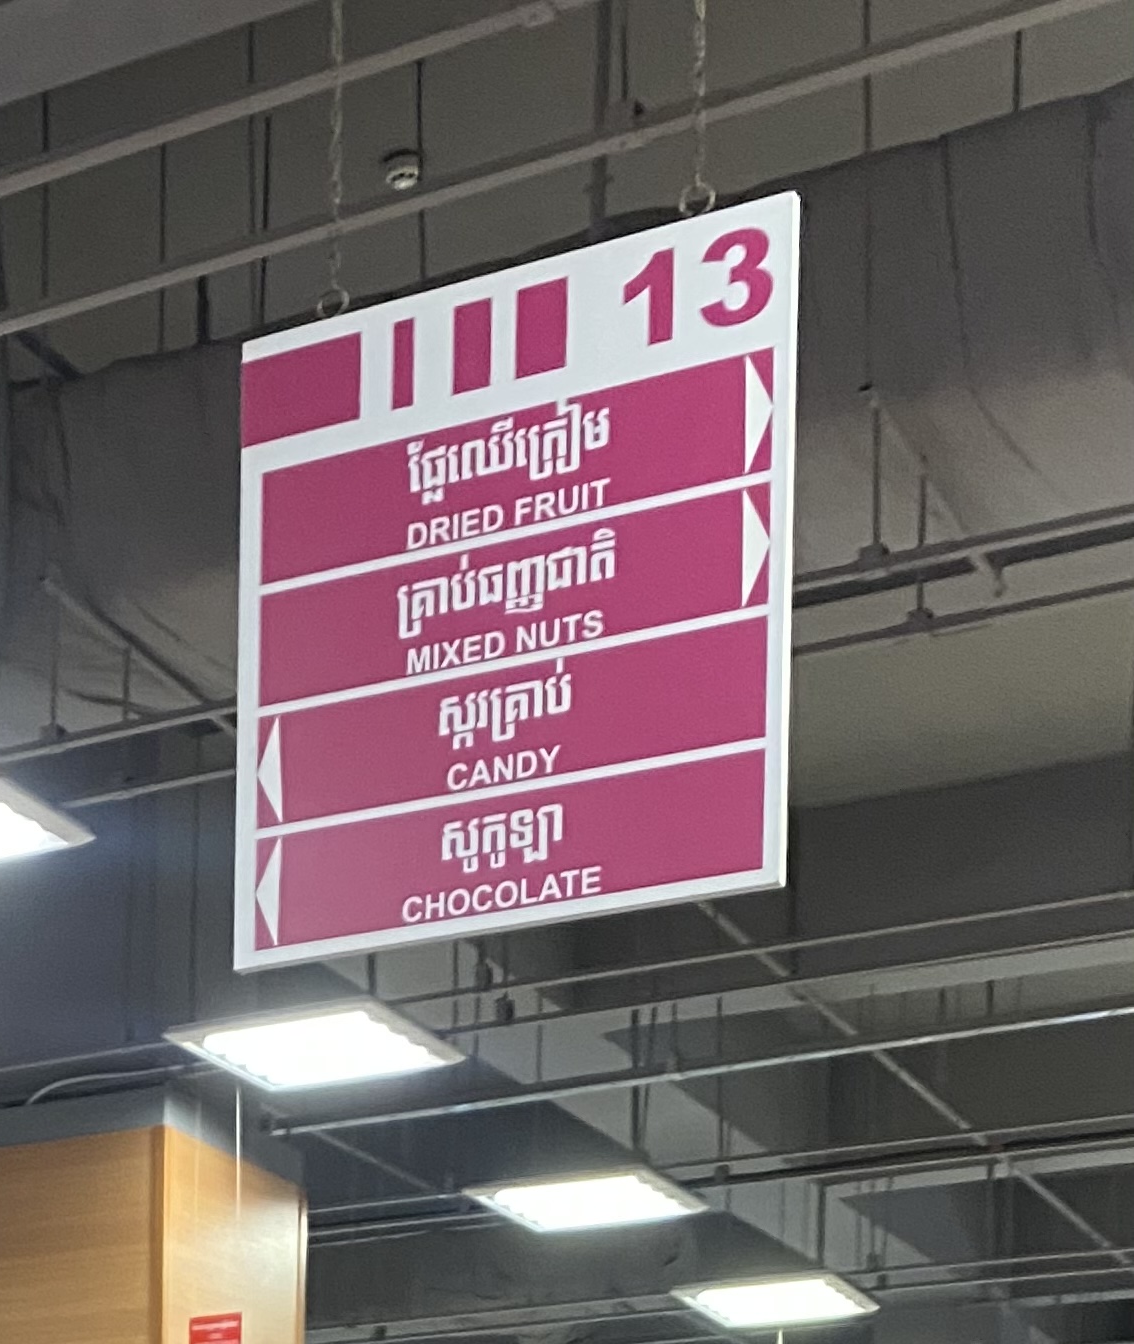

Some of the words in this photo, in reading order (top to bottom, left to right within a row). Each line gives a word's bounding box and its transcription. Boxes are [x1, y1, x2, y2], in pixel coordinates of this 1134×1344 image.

[623, 227, 774, 347] 13
[407, 505, 504, 550] DRIED
[514, 477, 611, 526] FRUIT
[406, 630, 505, 676] MIXED
[516, 609, 605, 653] NUTS
[446, 745, 562, 791] CANDY
[401, 865, 602, 924] CHOCOLATE
